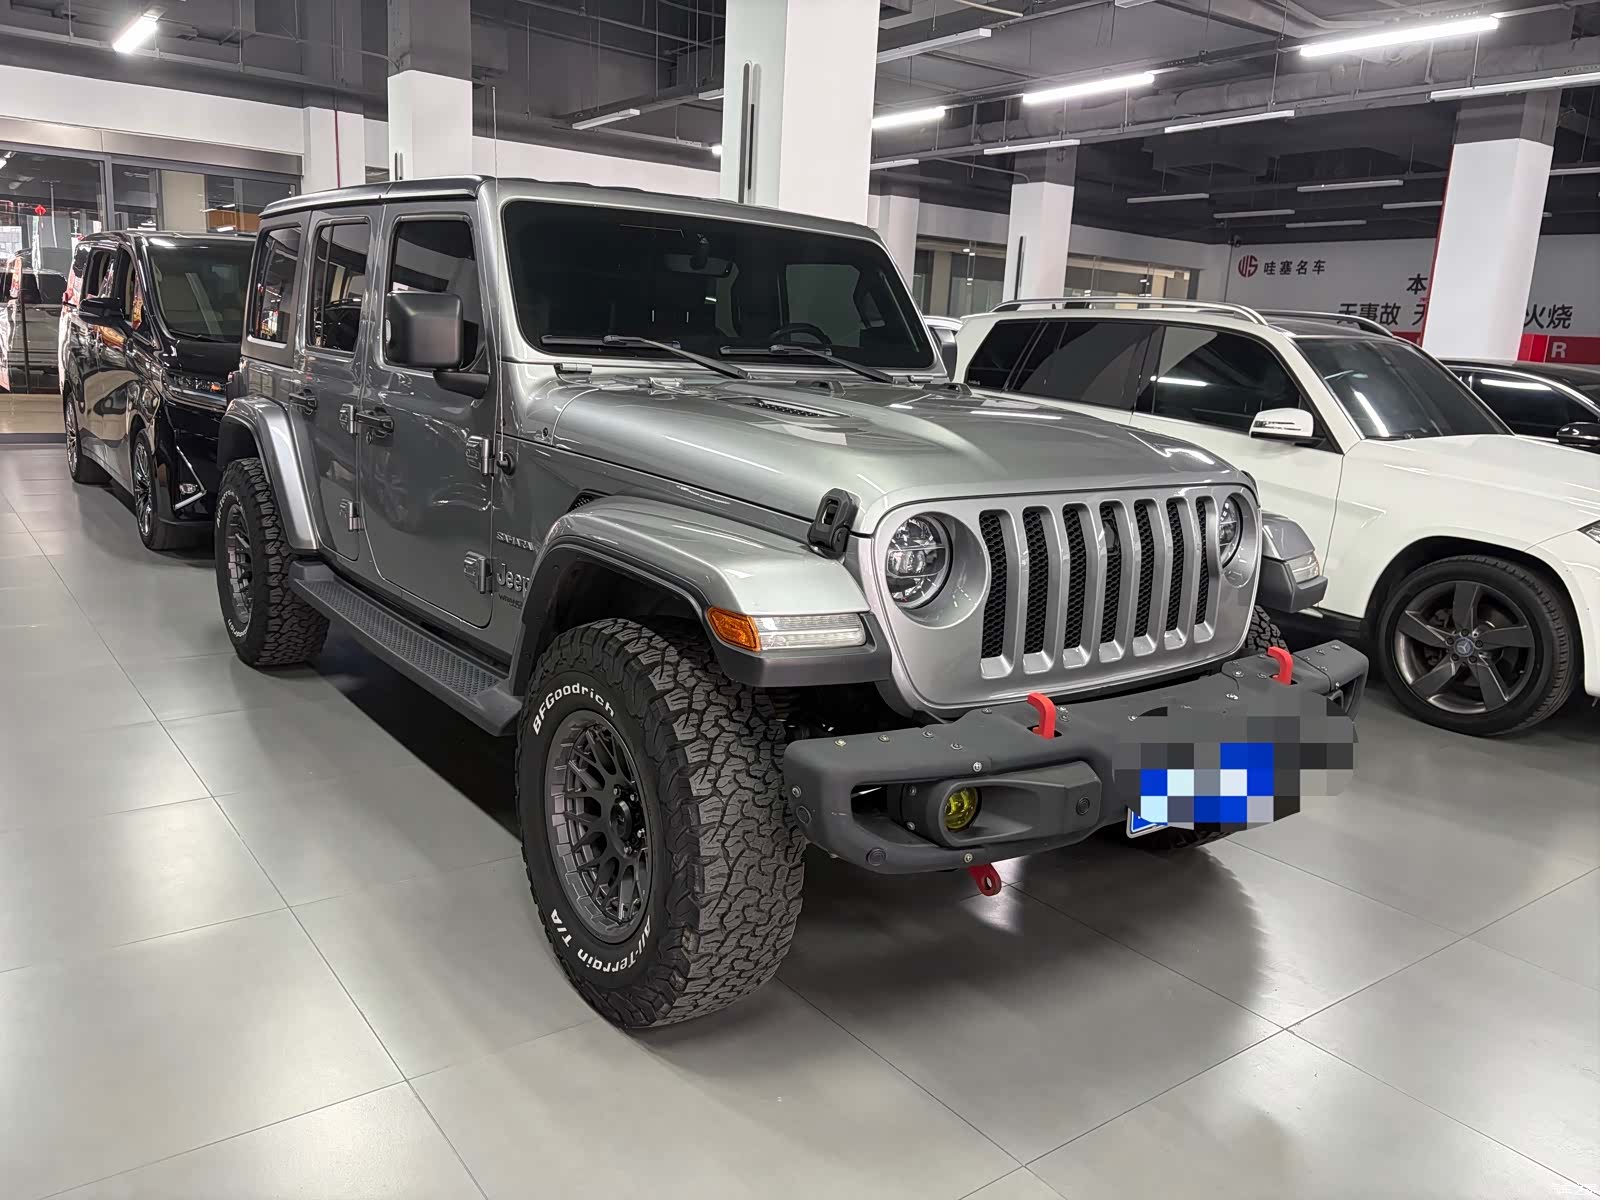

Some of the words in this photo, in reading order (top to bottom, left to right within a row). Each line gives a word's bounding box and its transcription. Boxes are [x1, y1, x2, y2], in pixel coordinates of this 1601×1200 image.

[1263, 260, 1326, 275] 哇塞名车
[1406, 273, 1428, 295] 本
[1524, 304, 1573, 329] 火烧
[1550, 341, 1567, 358] R
[496, 562, 531, 598] Jeep
[532, 682, 615, 735] BFGoodrich
[551, 908, 573, 947] T/A
[577, 914, 651, 972] All-Terrain
